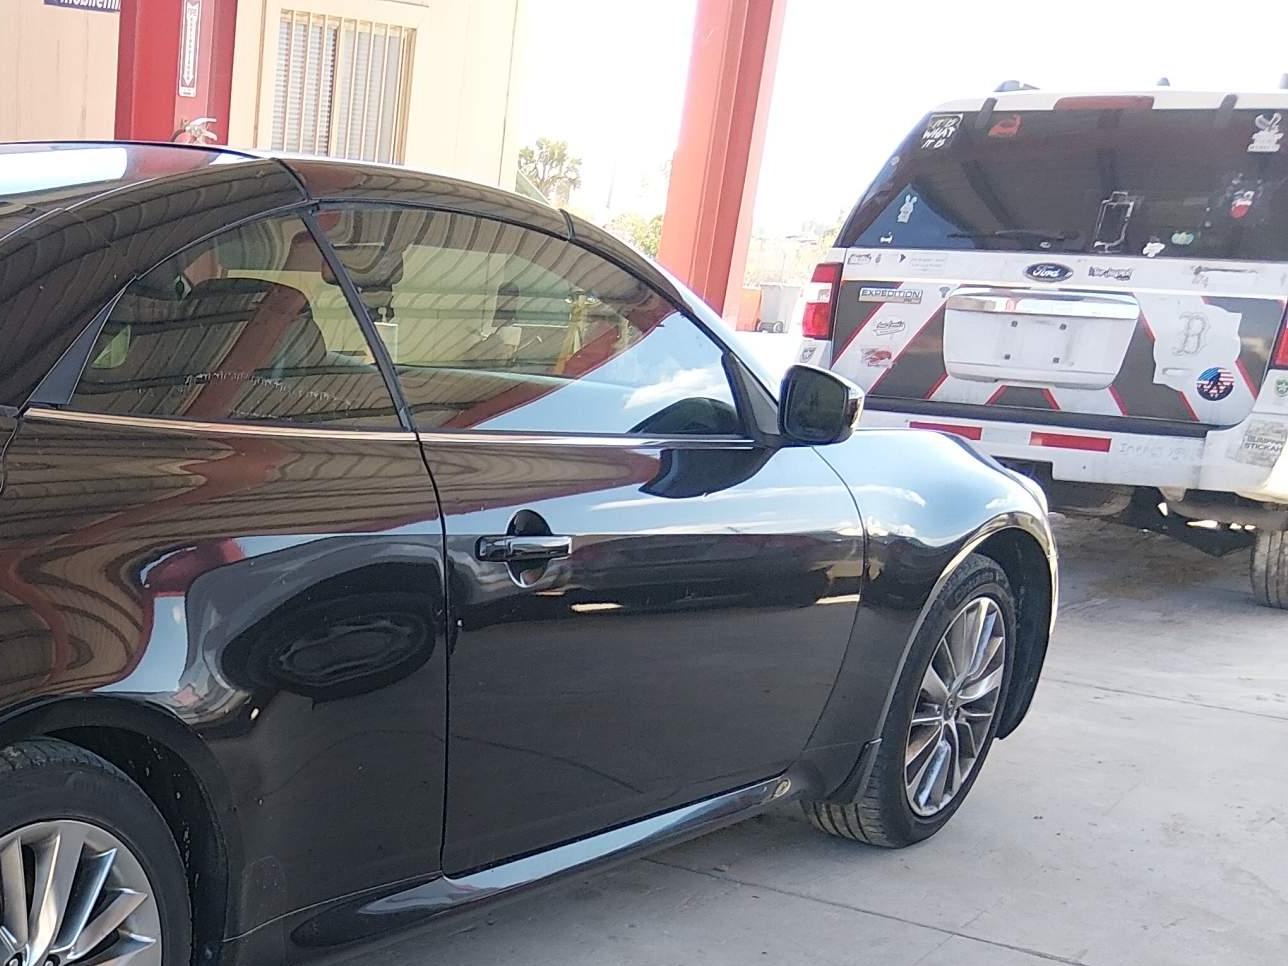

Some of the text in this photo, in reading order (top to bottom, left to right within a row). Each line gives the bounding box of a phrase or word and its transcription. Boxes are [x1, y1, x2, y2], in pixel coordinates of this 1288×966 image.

[922, 127, 955, 139] WHAT
[1032, 265, 1060, 278] Ford
[861, 289, 921, 299] EXPEDITION
